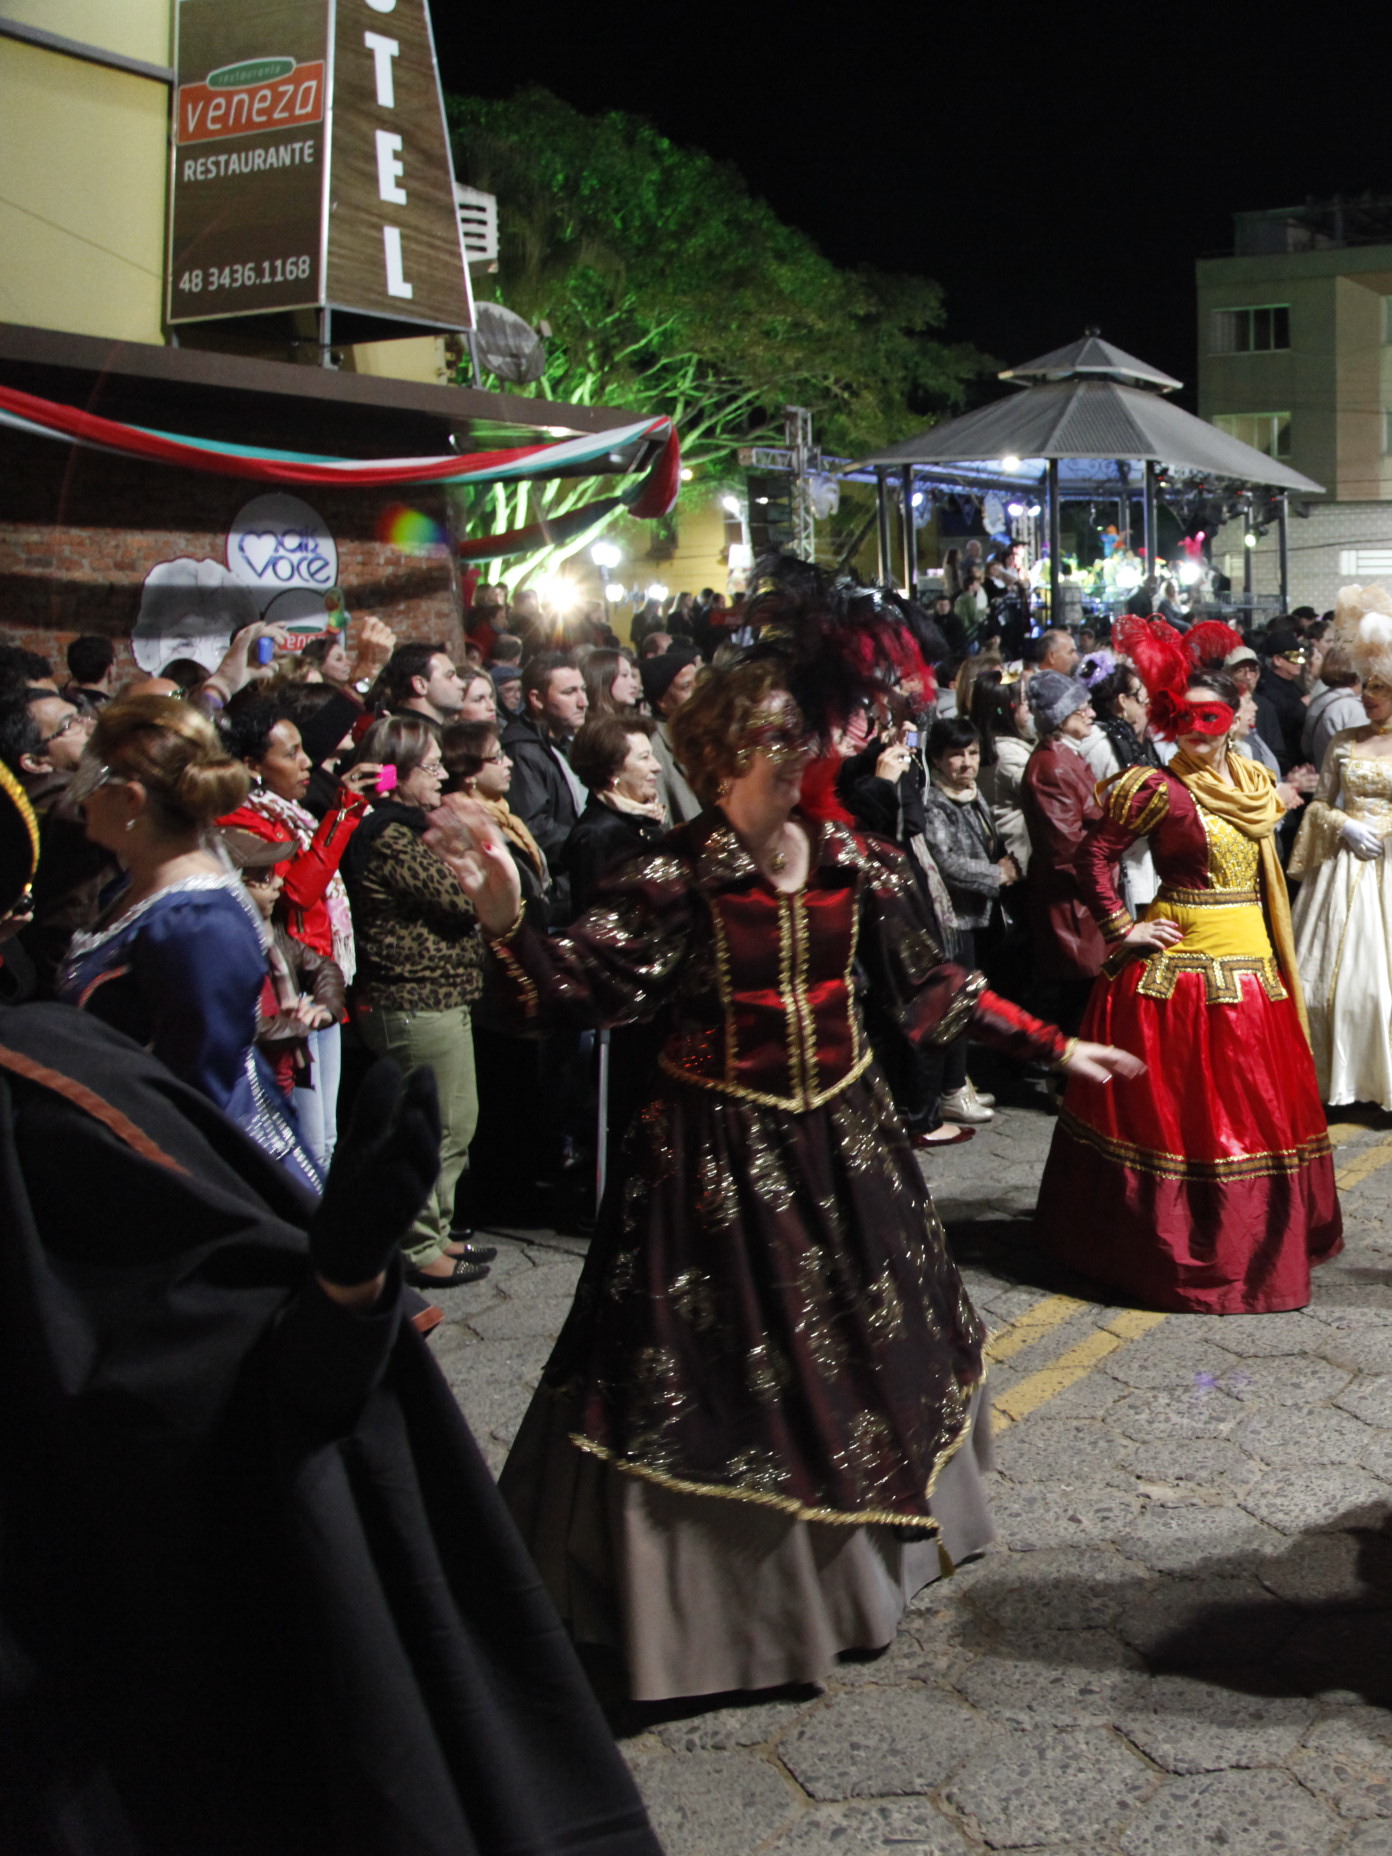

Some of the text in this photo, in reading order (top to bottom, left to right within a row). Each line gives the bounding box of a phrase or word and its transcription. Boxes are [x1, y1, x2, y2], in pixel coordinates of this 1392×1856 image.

[187, 80, 318, 134] veneza
[184, 140, 315, 183] RESTAURANTE
[179, 255, 310, 293] 48 3436.1168
